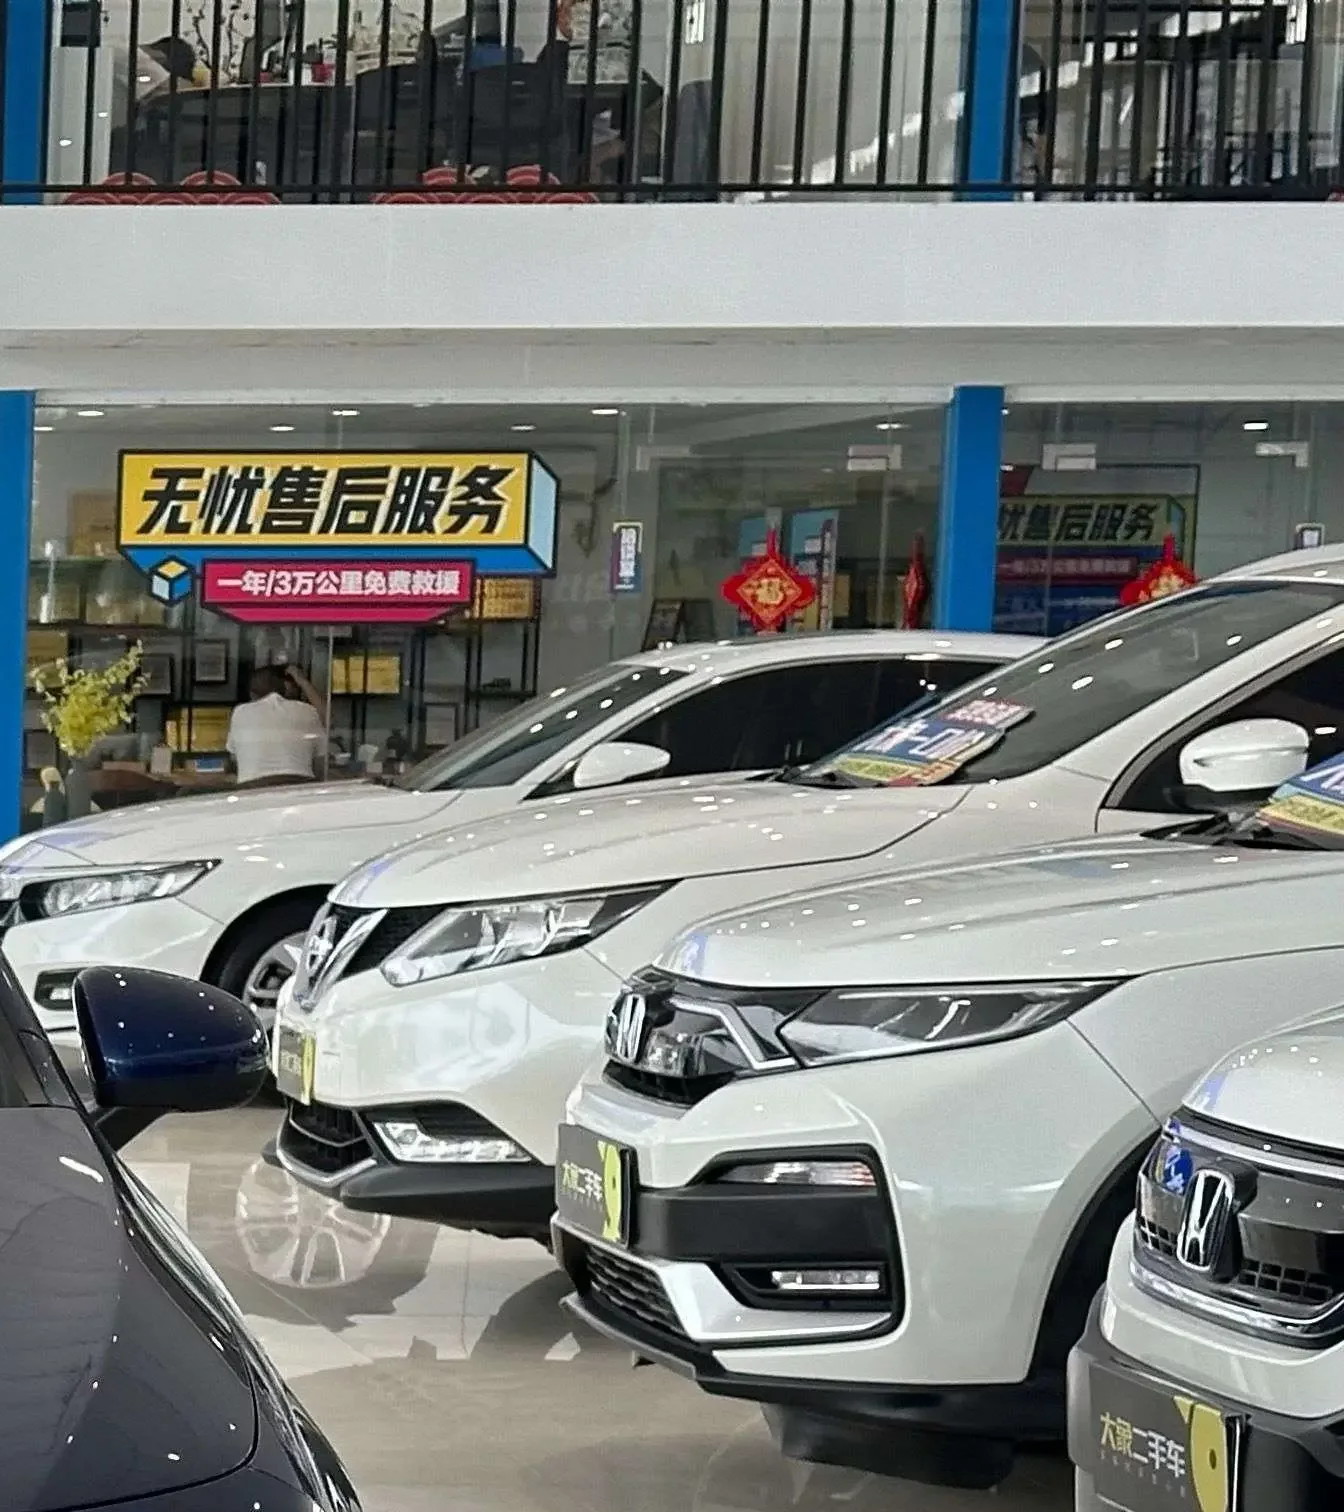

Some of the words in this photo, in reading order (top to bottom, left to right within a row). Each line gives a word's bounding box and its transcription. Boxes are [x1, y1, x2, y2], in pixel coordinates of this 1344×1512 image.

[136, 465, 517, 535] 无忧售后服务
[217, 570, 461, 597] 一年/3万公里免费救援
[1100, 1411, 1186, 1478] 大象二手车
